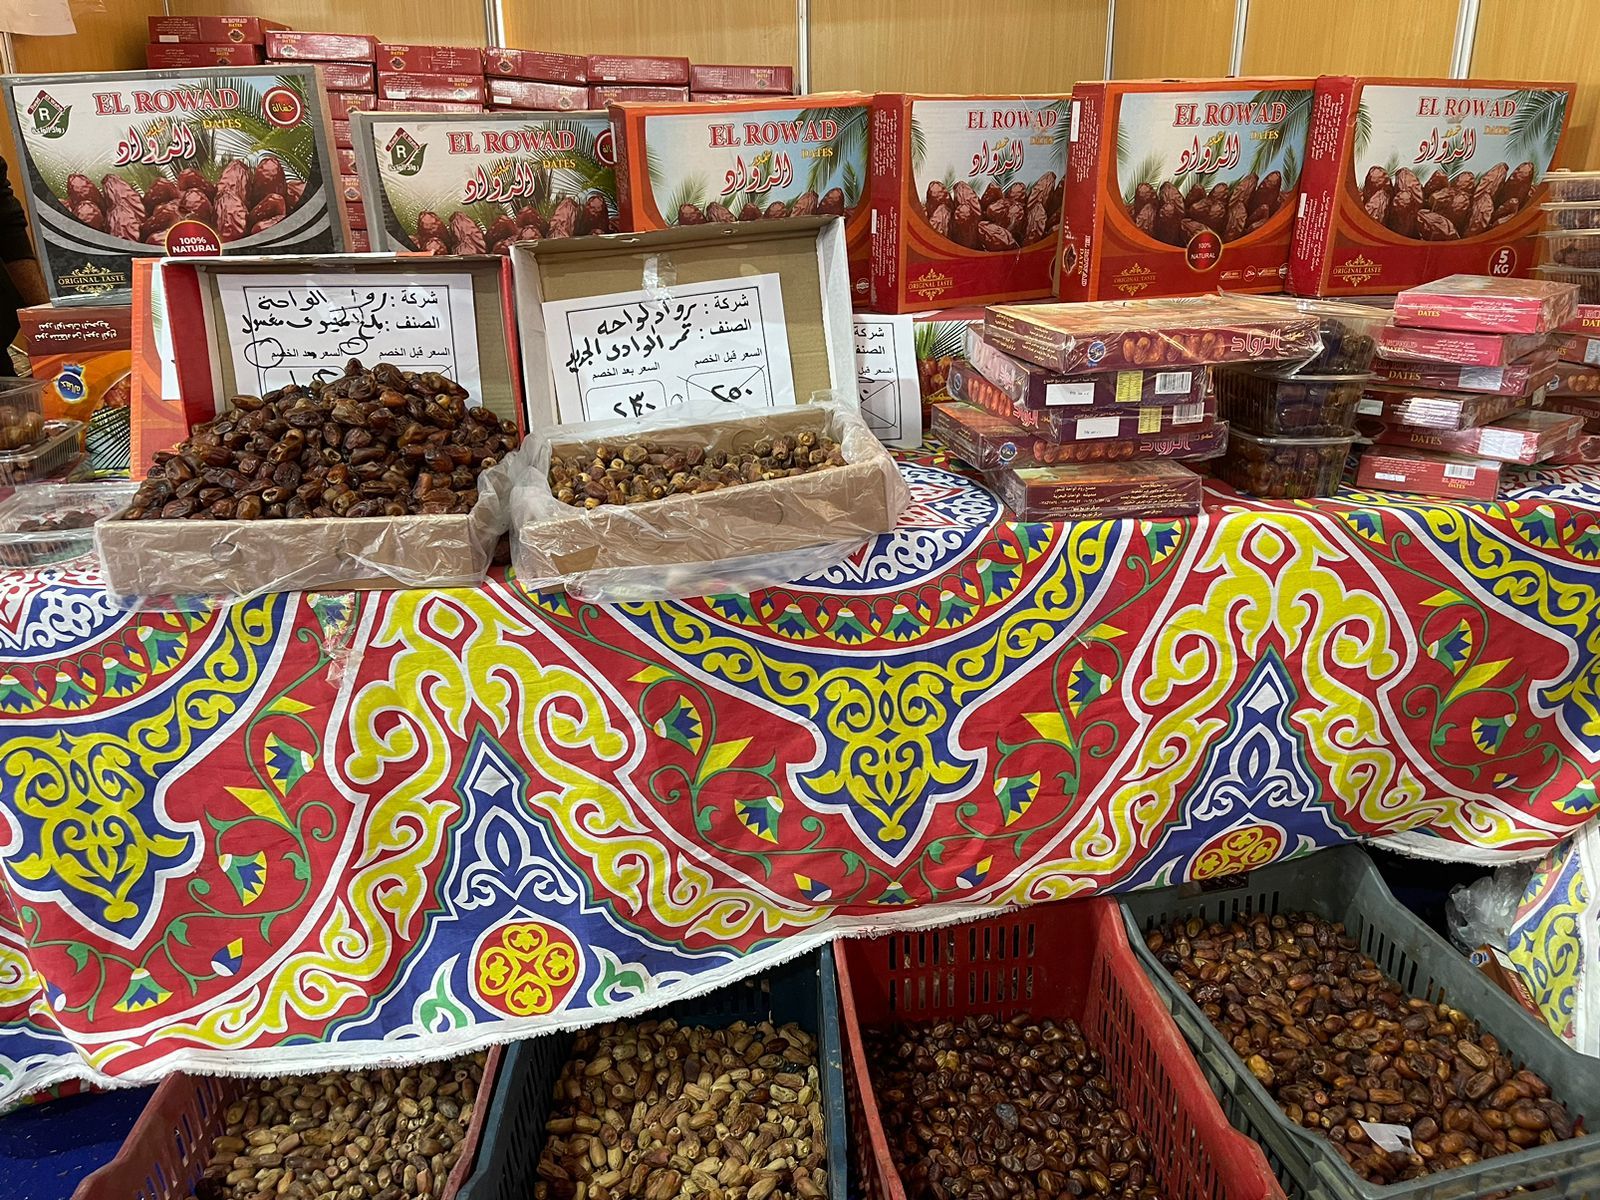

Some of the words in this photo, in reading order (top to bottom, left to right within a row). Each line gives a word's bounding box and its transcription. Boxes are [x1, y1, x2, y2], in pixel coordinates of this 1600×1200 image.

[92, 92, 131, 116] EL
[131, 88, 240, 115] ROWAD
[1416, 96, 1440, 117] EL
[1443, 96, 1517, 119] ROWAD
[38, 107, 50, 121] R
[967, 109, 988, 130] EL
[991, 108, 1058, 130] ROWAD
[1172, 103, 1200, 128] EL
[1202, 101, 1287, 126] ROWAD
[203, 119, 242, 130] DATES
[708, 123, 741, 148] EL
[743, 119, 839, 147] ROWAD
[114, 121, 197, 167] الرواد
[447, 131, 480, 155] EL
[483, 130, 577, 154] ROWAD
[1413, 127, 1478, 164] الرواد
[395, 145, 407, 158] R
[801, 147, 834, 159] DATES
[968, 139, 1024, 177] الرواد
[1174, 132, 1240, 176] الرواد
[543, 159, 577, 169] DATES
[720, 151, 794, 196] الرواد
[461, 161, 535, 205] الرواد
[179, 236, 207, 245] 100%
[172, 244, 218, 254] NATURAL
[1190, 251, 1216, 261] NATURAL
[1498, 249, 1509, 264] 5
[1333, 267, 1363, 275] ORIGINAL
[1363, 265, 1382, 274] TASTE
[1493, 264, 1509, 274] KG
[58, 276, 100, 286] ORIGINAL
[101, 274, 127, 283] TASTE
[908, 281, 936, 290] ORIGINAL
[401, 290, 438, 308] شركة
[714, 294, 749, 312] شركة
[396, 315, 440, 329] الصنف
[709, 318, 752, 335] الصنف
[854, 326, 884, 341] شركة
[379, 347, 407, 360] الخصم
[410, 346, 424, 358] قبل
[428, 347, 451, 358] السعر
[723, 350, 737, 363] قبل
[741, 347, 763, 362] السعر
[694, 353, 720, 368] الخصم
[592, 367, 619, 382] الخصم
[621, 366, 634, 376] بعد
[638, 362, 660, 376] السعر
[1388, 370, 1421, 381] DATES
[1139, 432, 1191, 456] الرواد
[1410, 433, 1442, 445] DATES
